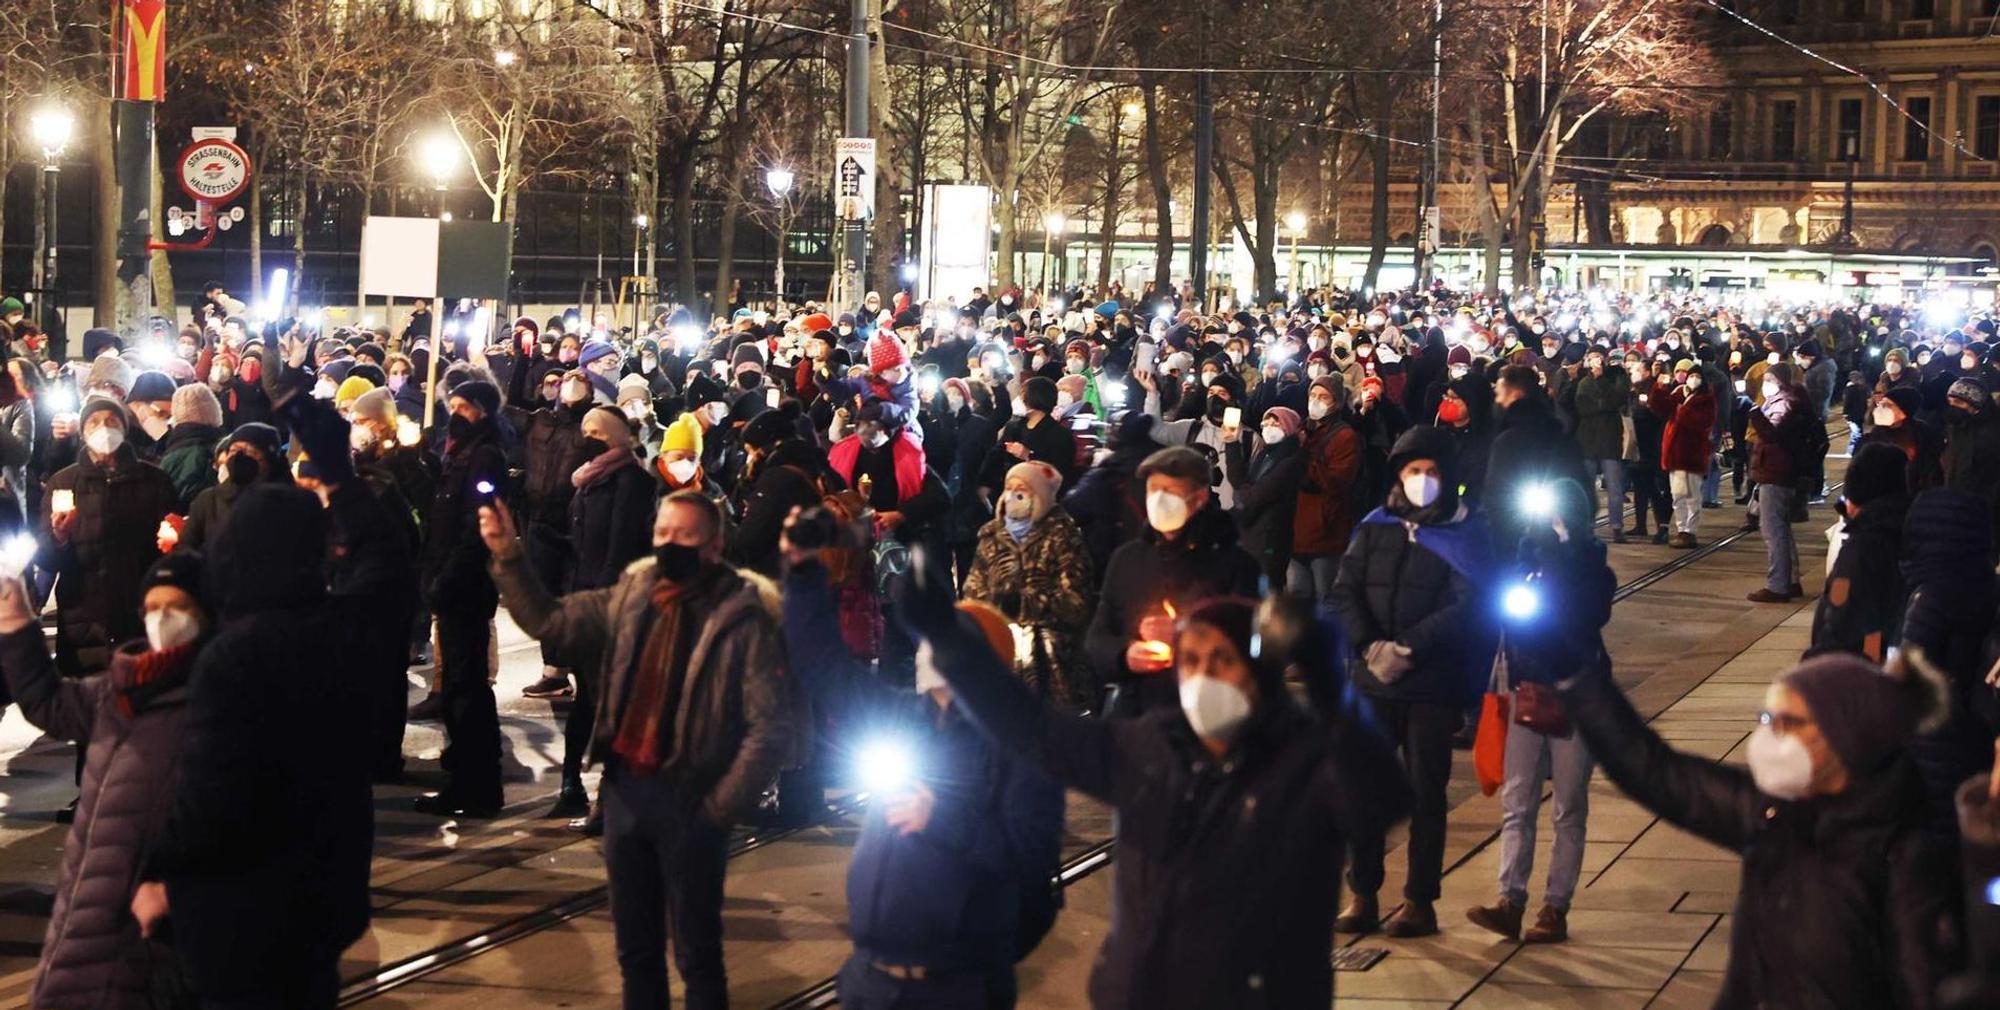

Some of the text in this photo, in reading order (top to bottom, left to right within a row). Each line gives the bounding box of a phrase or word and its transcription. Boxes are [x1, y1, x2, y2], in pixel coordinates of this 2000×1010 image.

[187, 148, 241, 168] STRASSENBAHN
[189, 177, 239, 194] HALTESTELLE
[184, 219, 190, 227] 2
